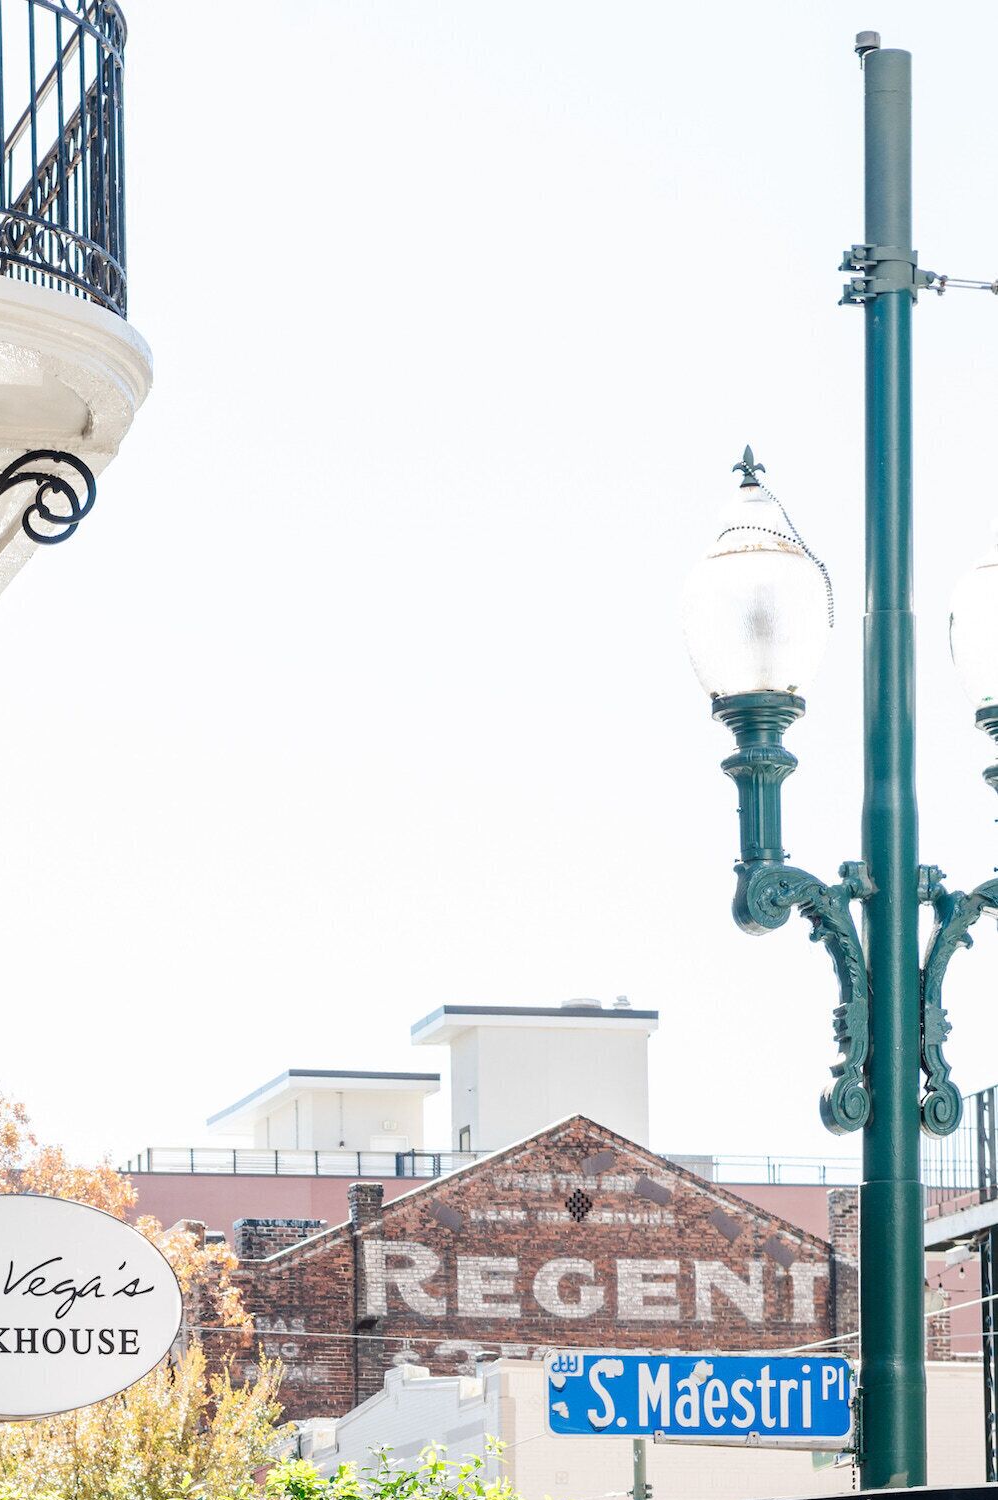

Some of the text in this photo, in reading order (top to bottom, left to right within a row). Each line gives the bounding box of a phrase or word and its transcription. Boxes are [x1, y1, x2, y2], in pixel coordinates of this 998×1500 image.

[2, 1257, 155, 1319] Vega's
[361, 1240, 830, 1323] REGENT
[588, 1359, 845, 1431] S. Maestri Pl
